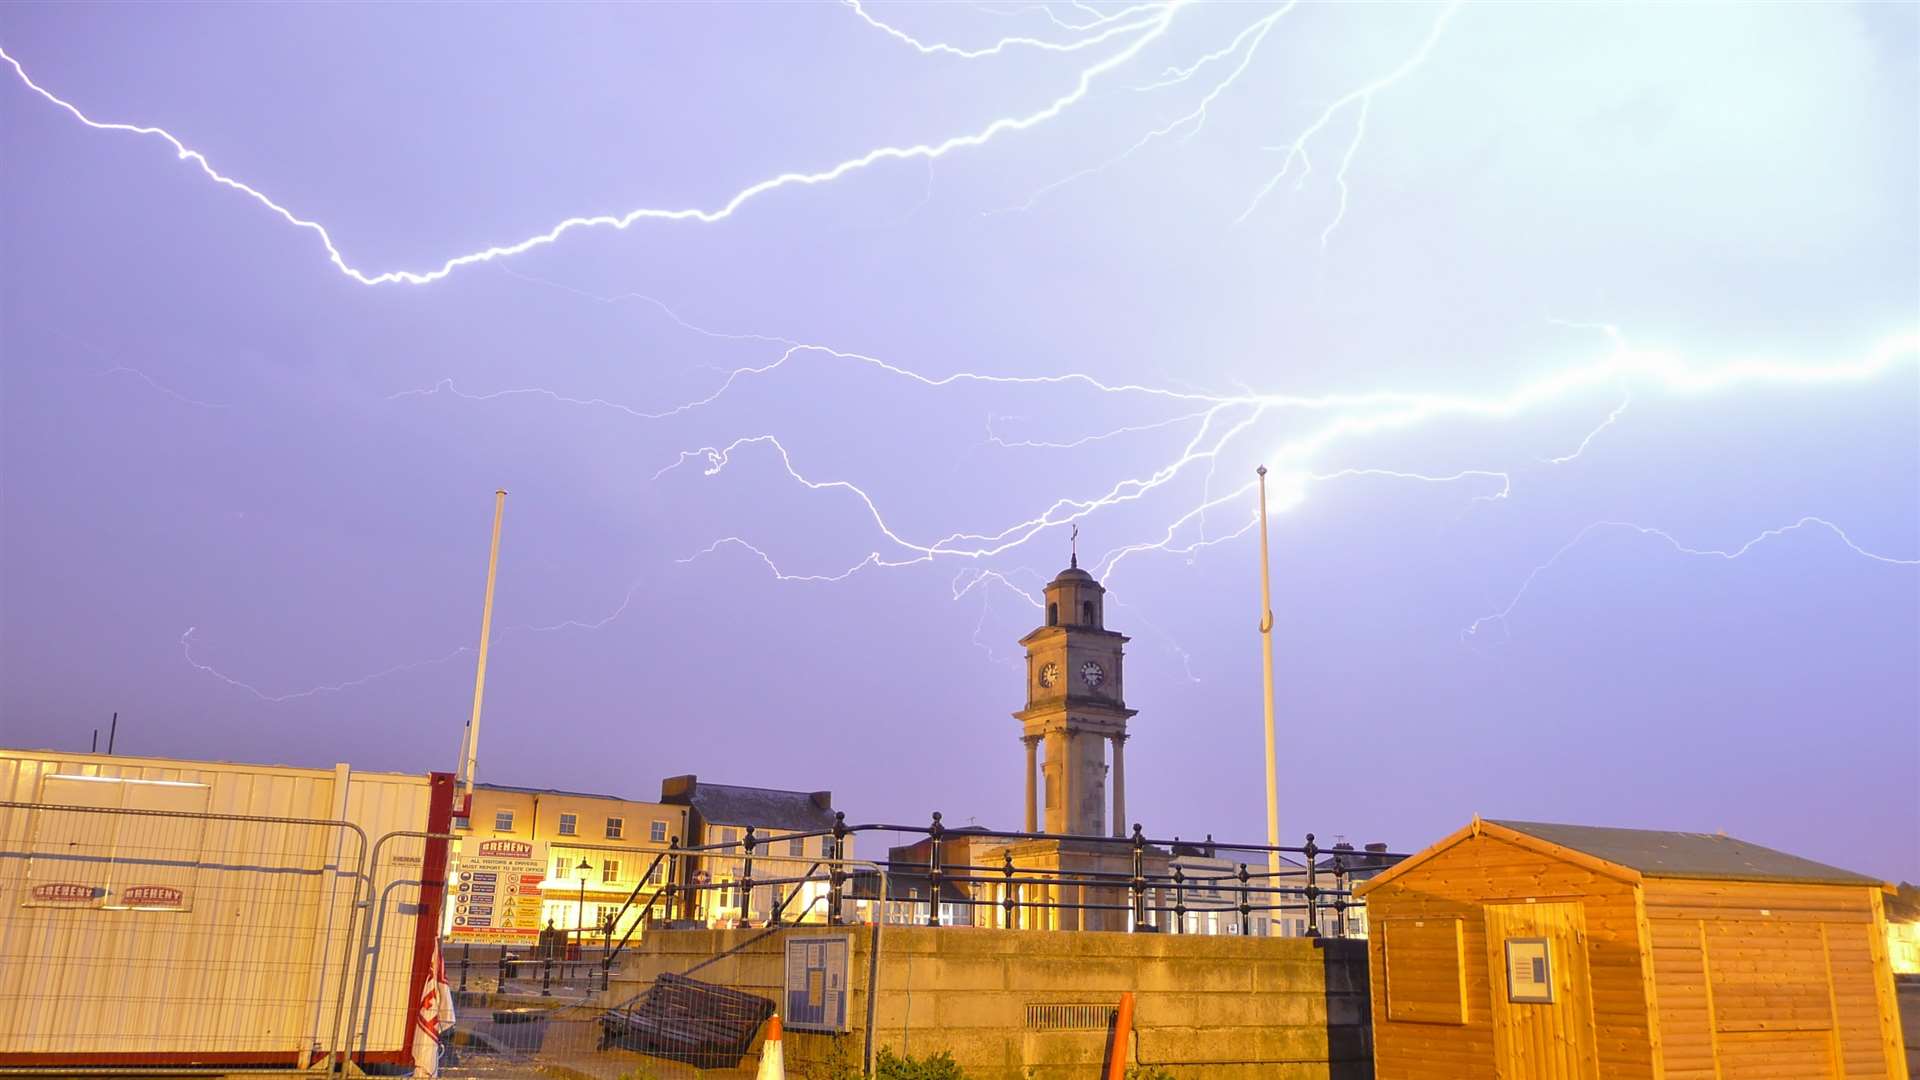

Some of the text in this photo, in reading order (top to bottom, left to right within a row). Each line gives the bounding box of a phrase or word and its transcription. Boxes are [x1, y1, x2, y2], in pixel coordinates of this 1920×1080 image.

[482, 841, 531, 852] BREHENY
[36, 885, 93, 897] BREHENY
[125, 888, 181, 899] BREHENY
